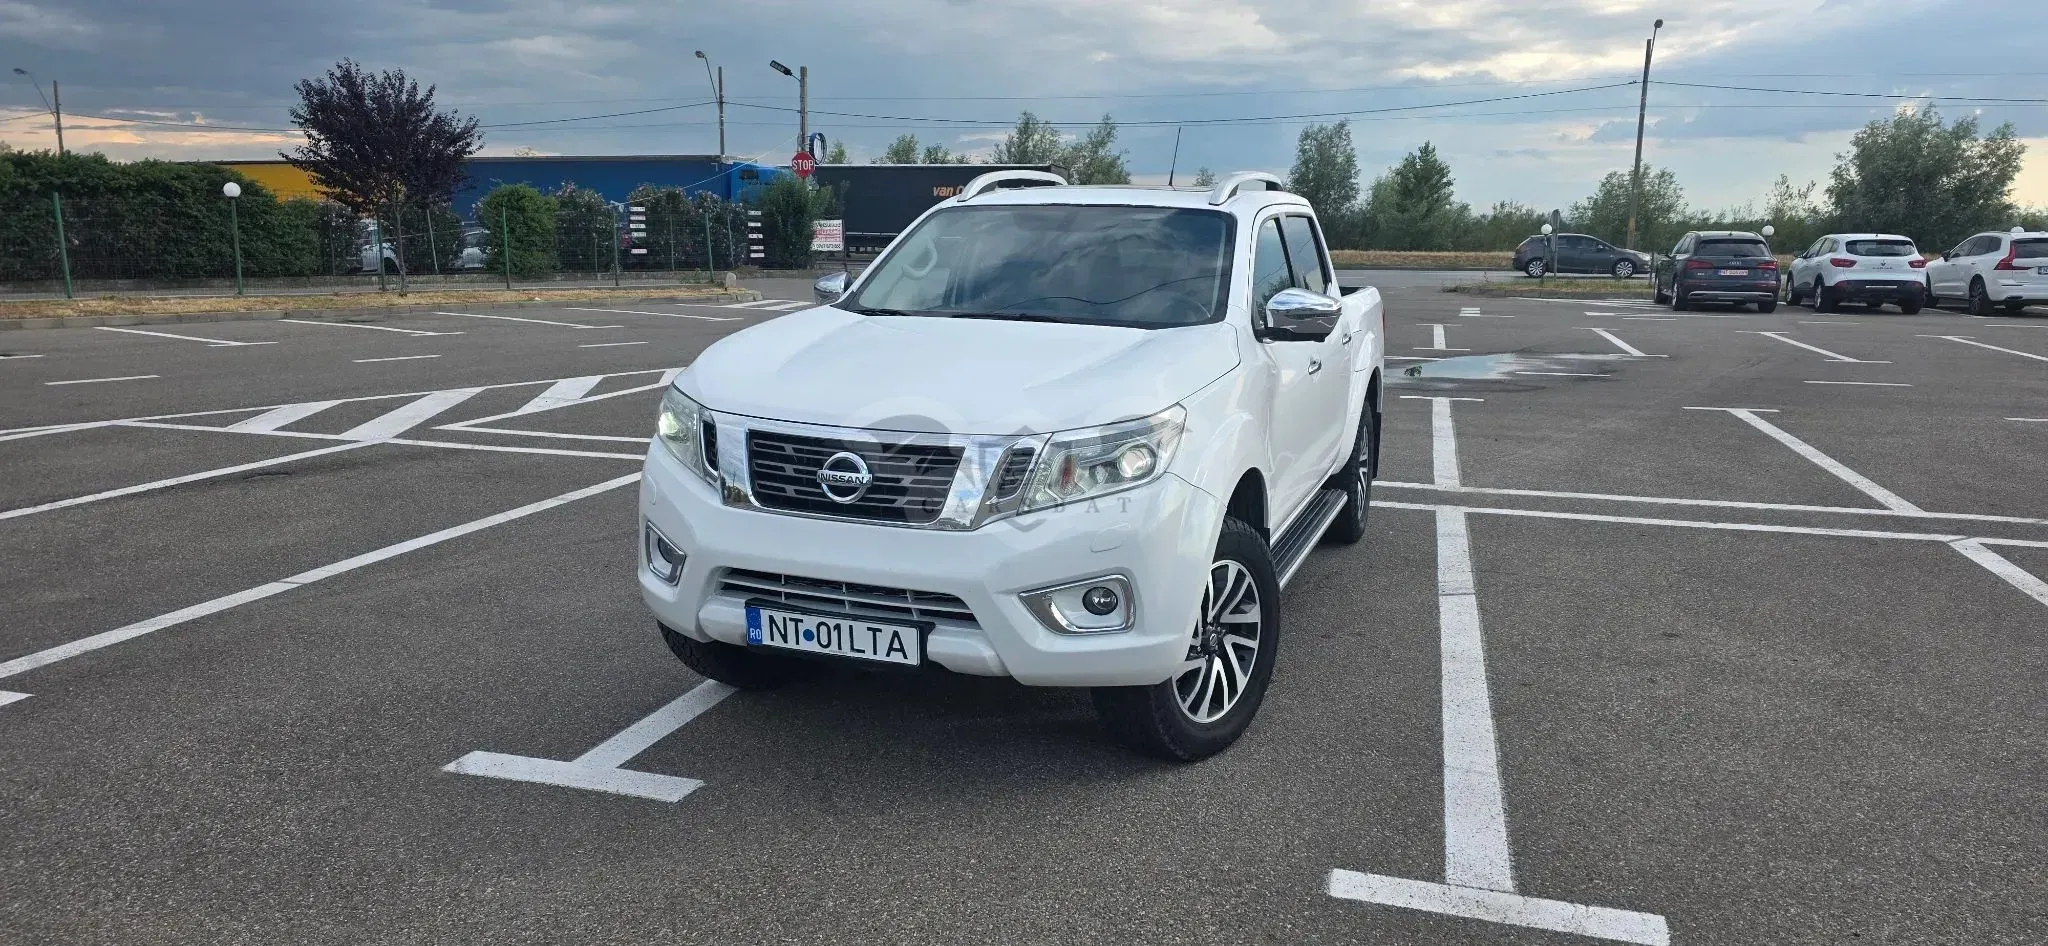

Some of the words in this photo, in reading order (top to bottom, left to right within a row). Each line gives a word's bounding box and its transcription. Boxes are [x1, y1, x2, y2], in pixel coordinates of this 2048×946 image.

[792, 159, 814, 171] STOP
[933, 186, 954, 197] van
[819, 472, 865, 485] NISSAN
[749, 628, 762, 640] RO
